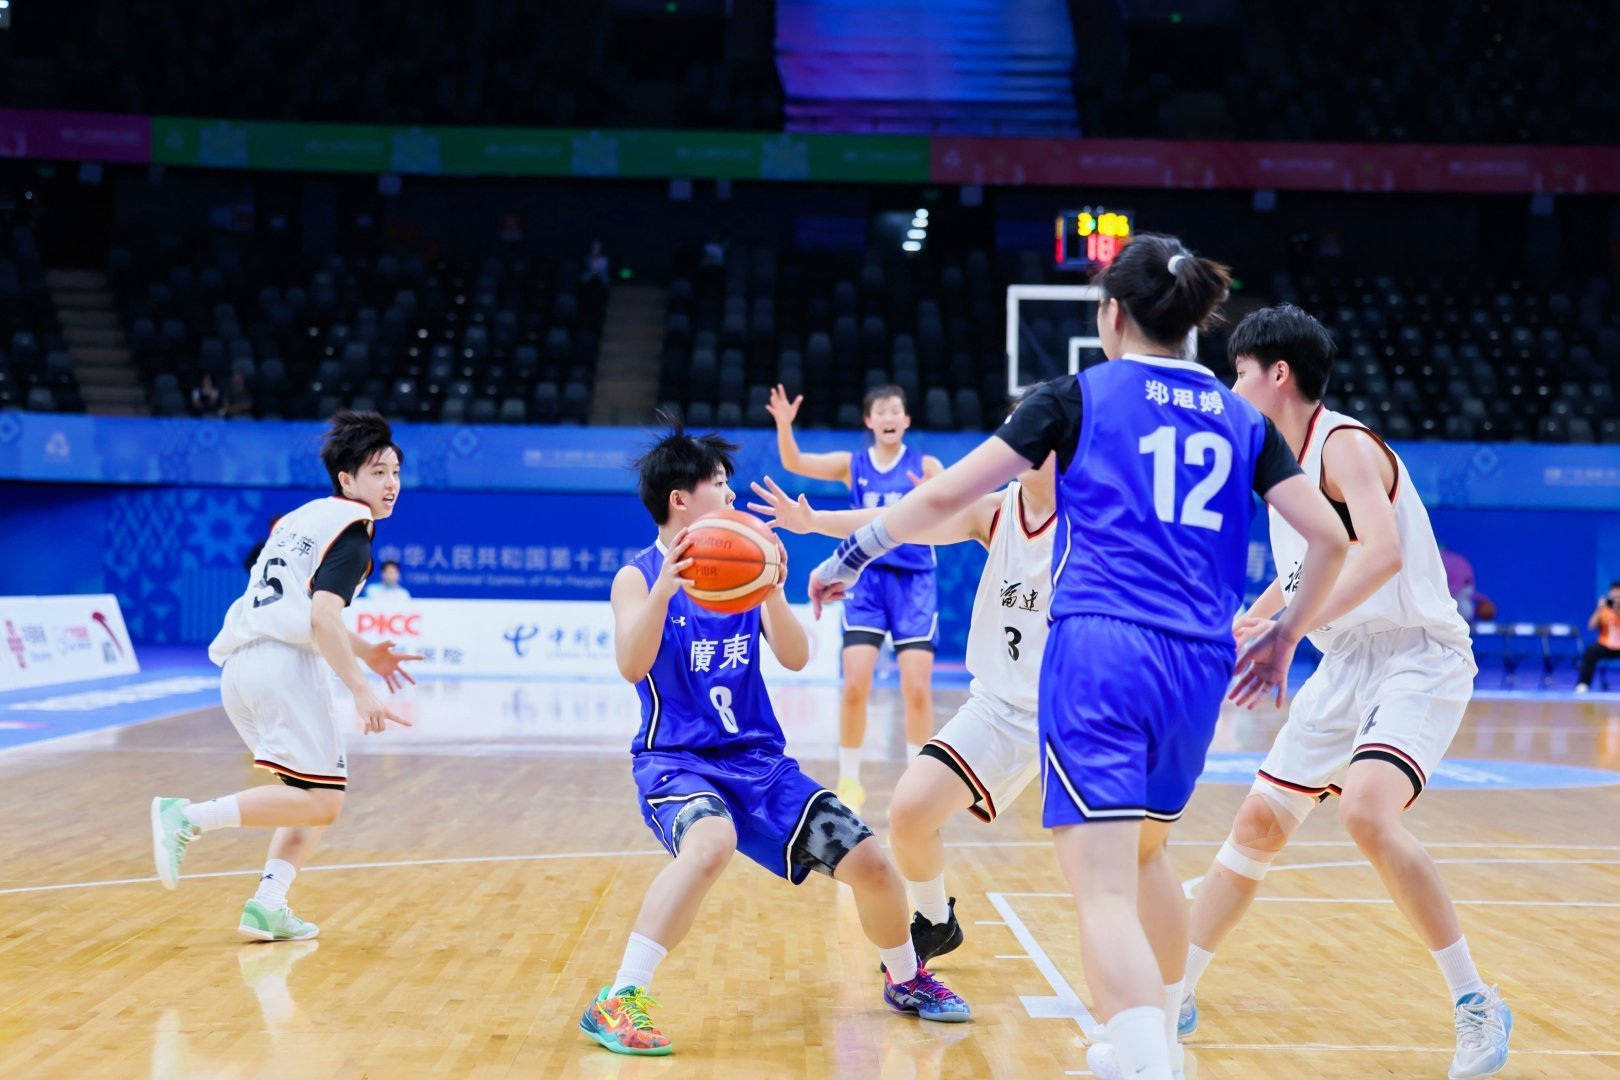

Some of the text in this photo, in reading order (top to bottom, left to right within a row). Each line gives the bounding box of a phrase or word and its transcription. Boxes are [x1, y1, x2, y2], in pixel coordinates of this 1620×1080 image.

[1139, 426, 1232, 532] 12
[253, 557, 287, 608] 5
[358, 614, 421, 637] PICC
[1005, 626, 1022, 661] 3
[690, 634, 751, 672] 廣東
[709, 686, 739, 734] 8
[1359, 704, 1380, 736] 4
